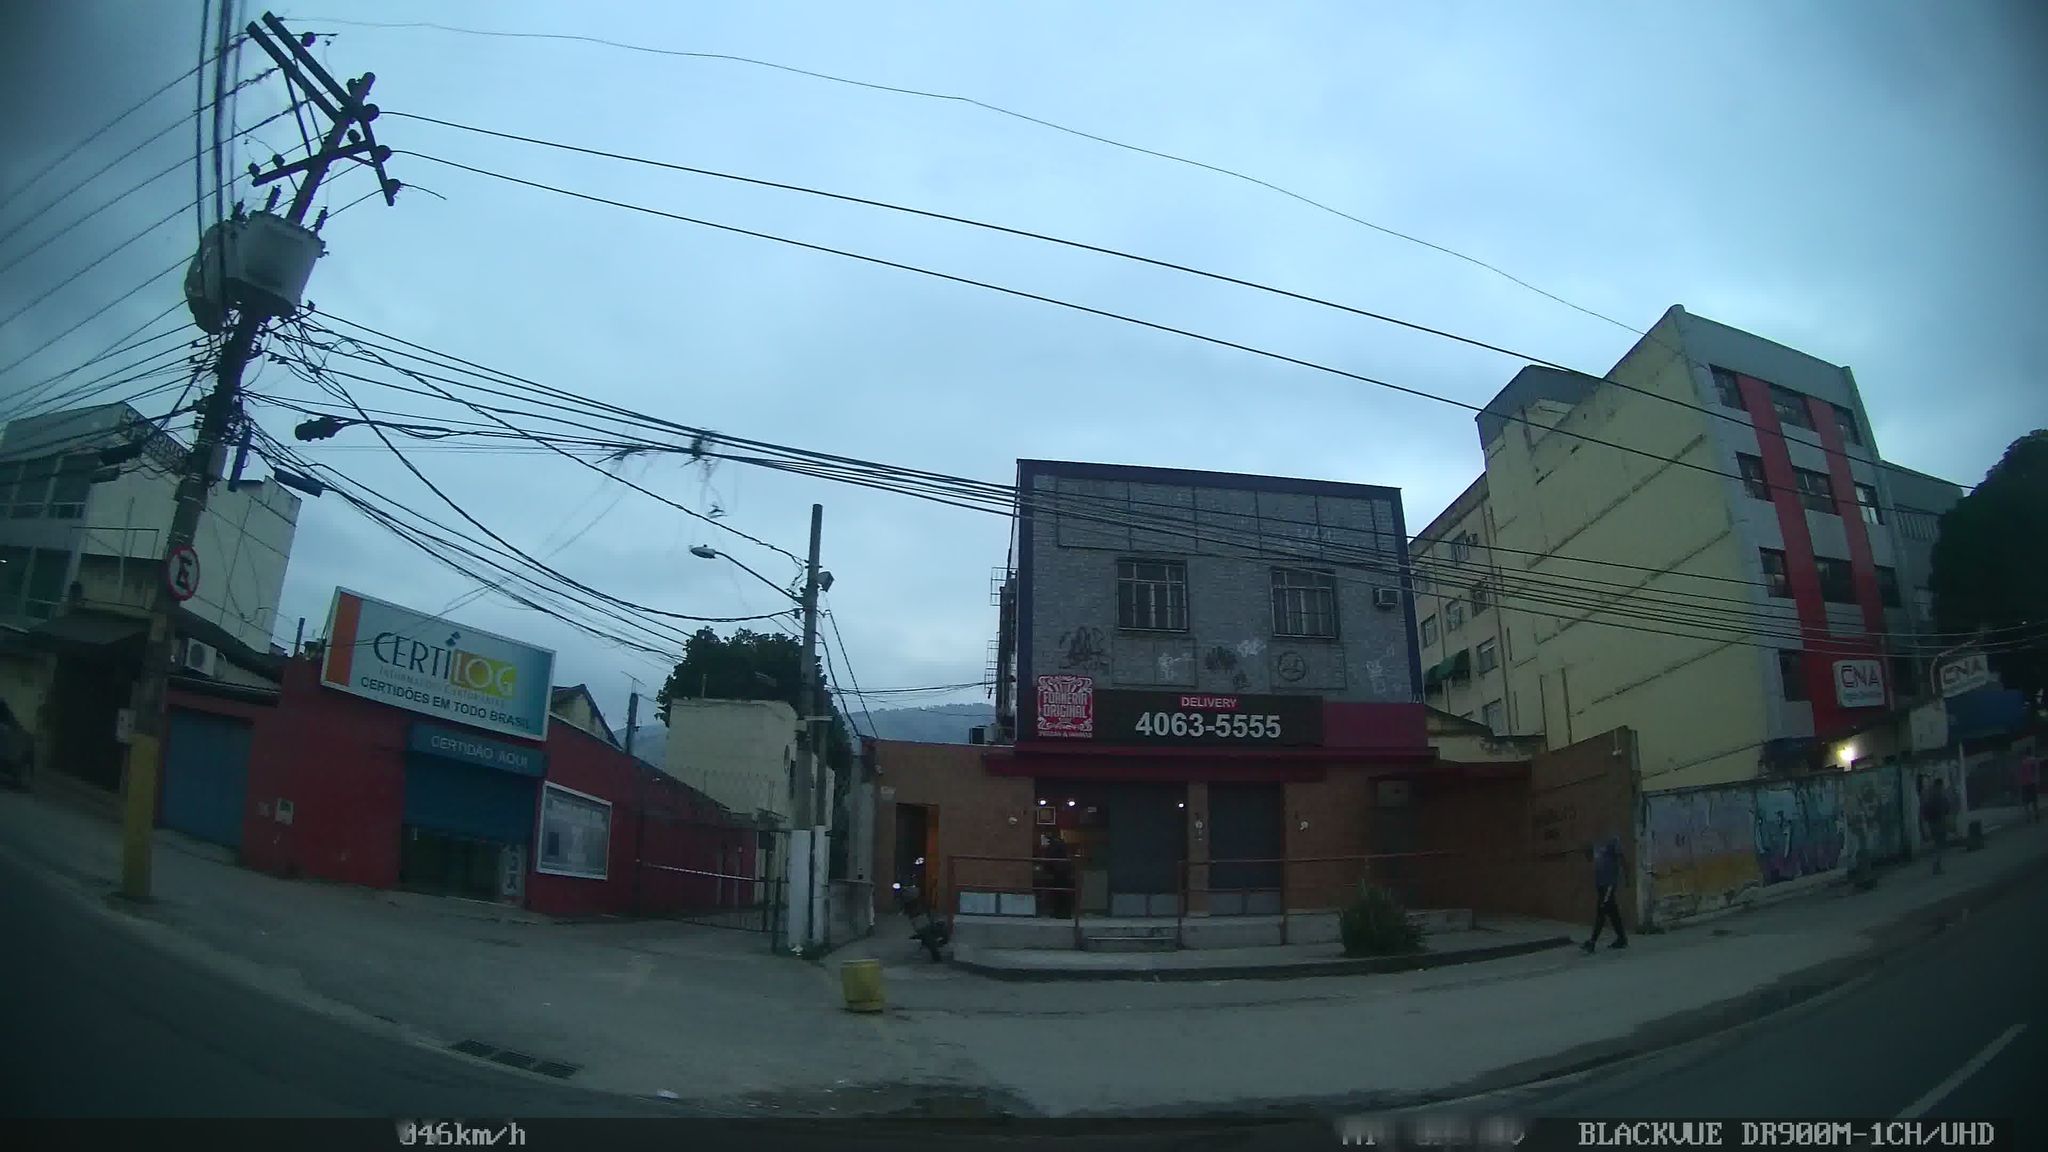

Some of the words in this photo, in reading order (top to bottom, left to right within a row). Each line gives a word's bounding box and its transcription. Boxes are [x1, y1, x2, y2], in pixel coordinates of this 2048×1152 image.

[373, 631, 514, 697] CERTILOG
[1840, 664, 1881, 688] CNA
[360, 676, 429, 704] CERTIDÕES
[432, 696, 450, 710] EM
[453, 701, 487, 719] TODO
[490, 711, 530, 729] BRASIL
[1043, 704, 1088, 718] ORIGINAL
[1181, 697, 1237, 708] DELIVERY
[1135, 711, 1281, 739] 4063-5555
[430, 734, 494, 761] CERTIDÃO
[498, 749, 529, 769] AQUI
